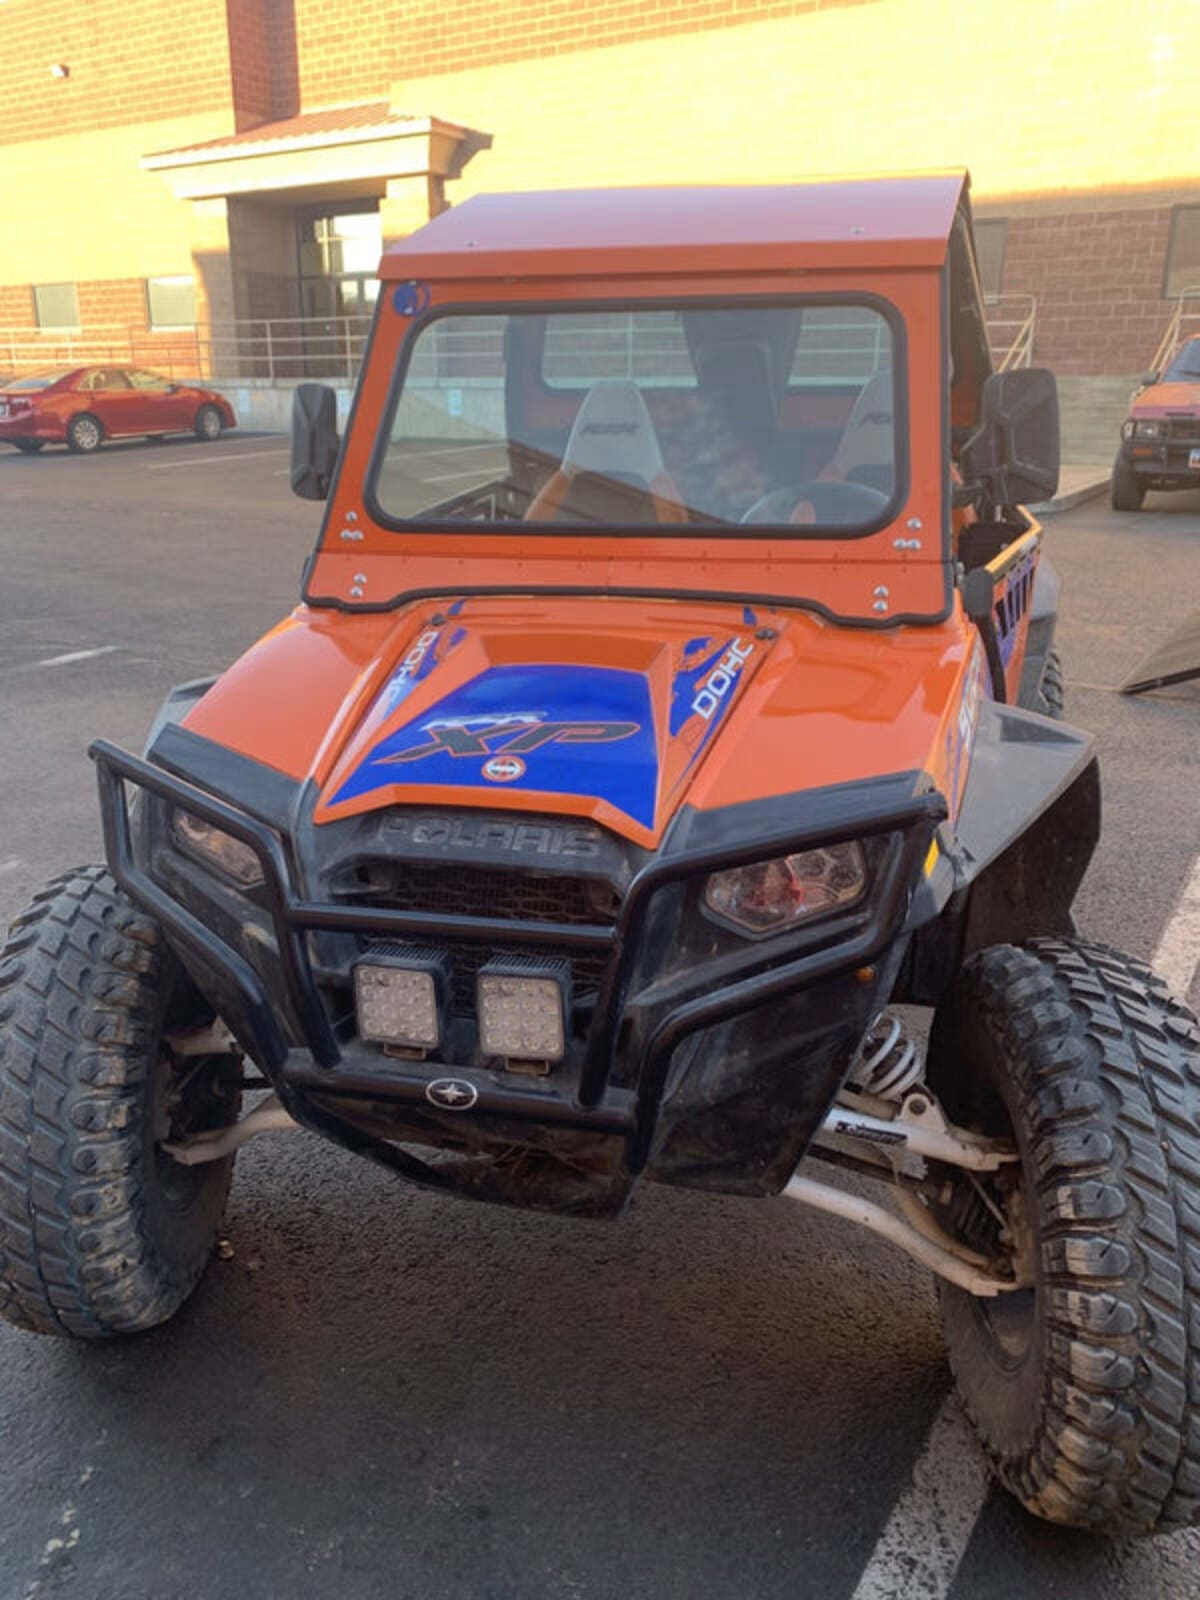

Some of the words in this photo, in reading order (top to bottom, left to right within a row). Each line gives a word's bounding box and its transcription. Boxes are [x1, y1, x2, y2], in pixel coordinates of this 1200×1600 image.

[691, 637, 755, 720] DOHC
[371, 720, 641, 765] XP
[377, 816, 600, 857] POLARIS
